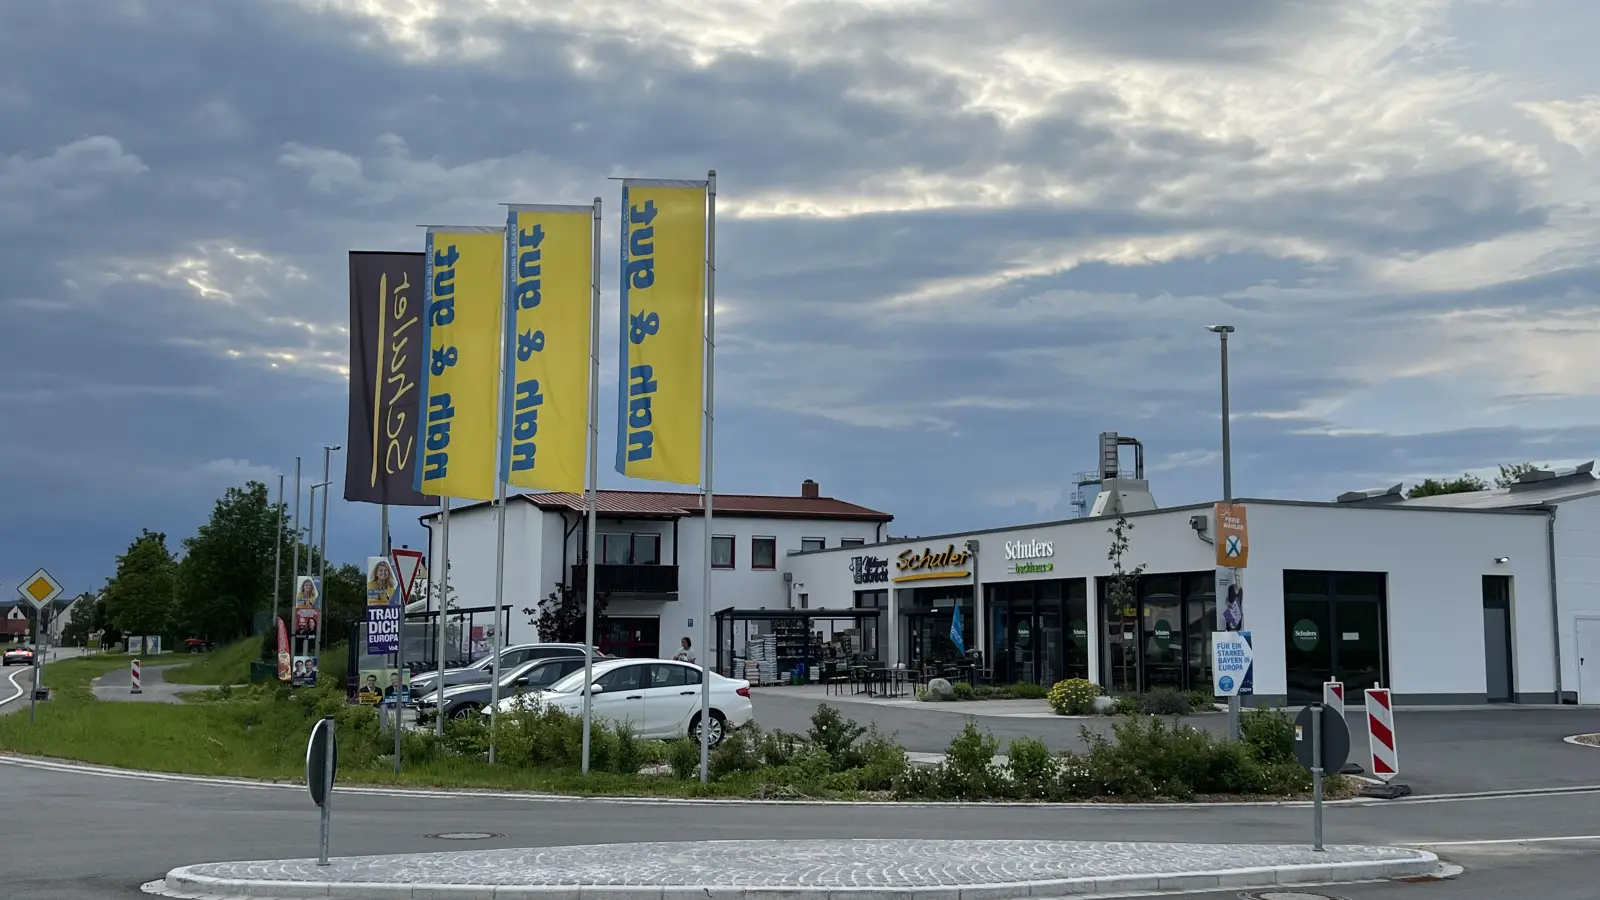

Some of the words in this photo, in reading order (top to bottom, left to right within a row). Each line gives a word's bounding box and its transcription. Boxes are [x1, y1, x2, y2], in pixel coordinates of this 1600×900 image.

[1005, 539, 1053, 560] Schulers
[896, 544, 972, 570] Schuler
[369, 608, 398, 620] TRAU
[369, 621, 398, 634] DICH
[369, 634, 398, 643] EUROPA
[1217, 642, 1230, 650] FÜR
